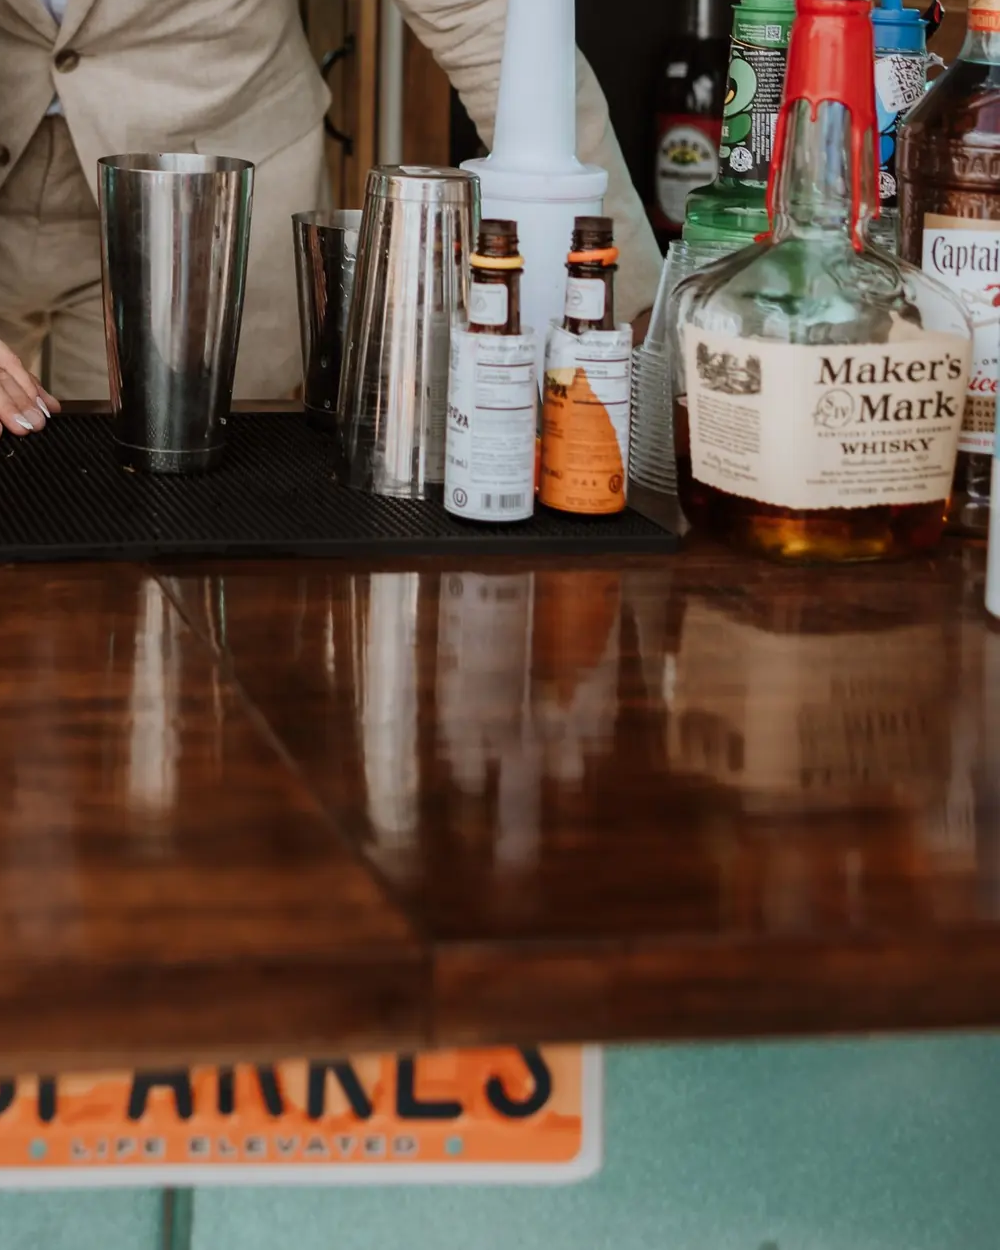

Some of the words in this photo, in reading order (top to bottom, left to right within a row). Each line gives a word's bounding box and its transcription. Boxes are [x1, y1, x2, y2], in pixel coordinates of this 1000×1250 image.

[816, 353, 962, 385] Maker's
[857, 391, 957, 423] Mark
[840, 437, 935, 456] WHISKY
[70, 1136, 167, 1161] LIFE
[189, 1133, 417, 1161] ELEVATED
